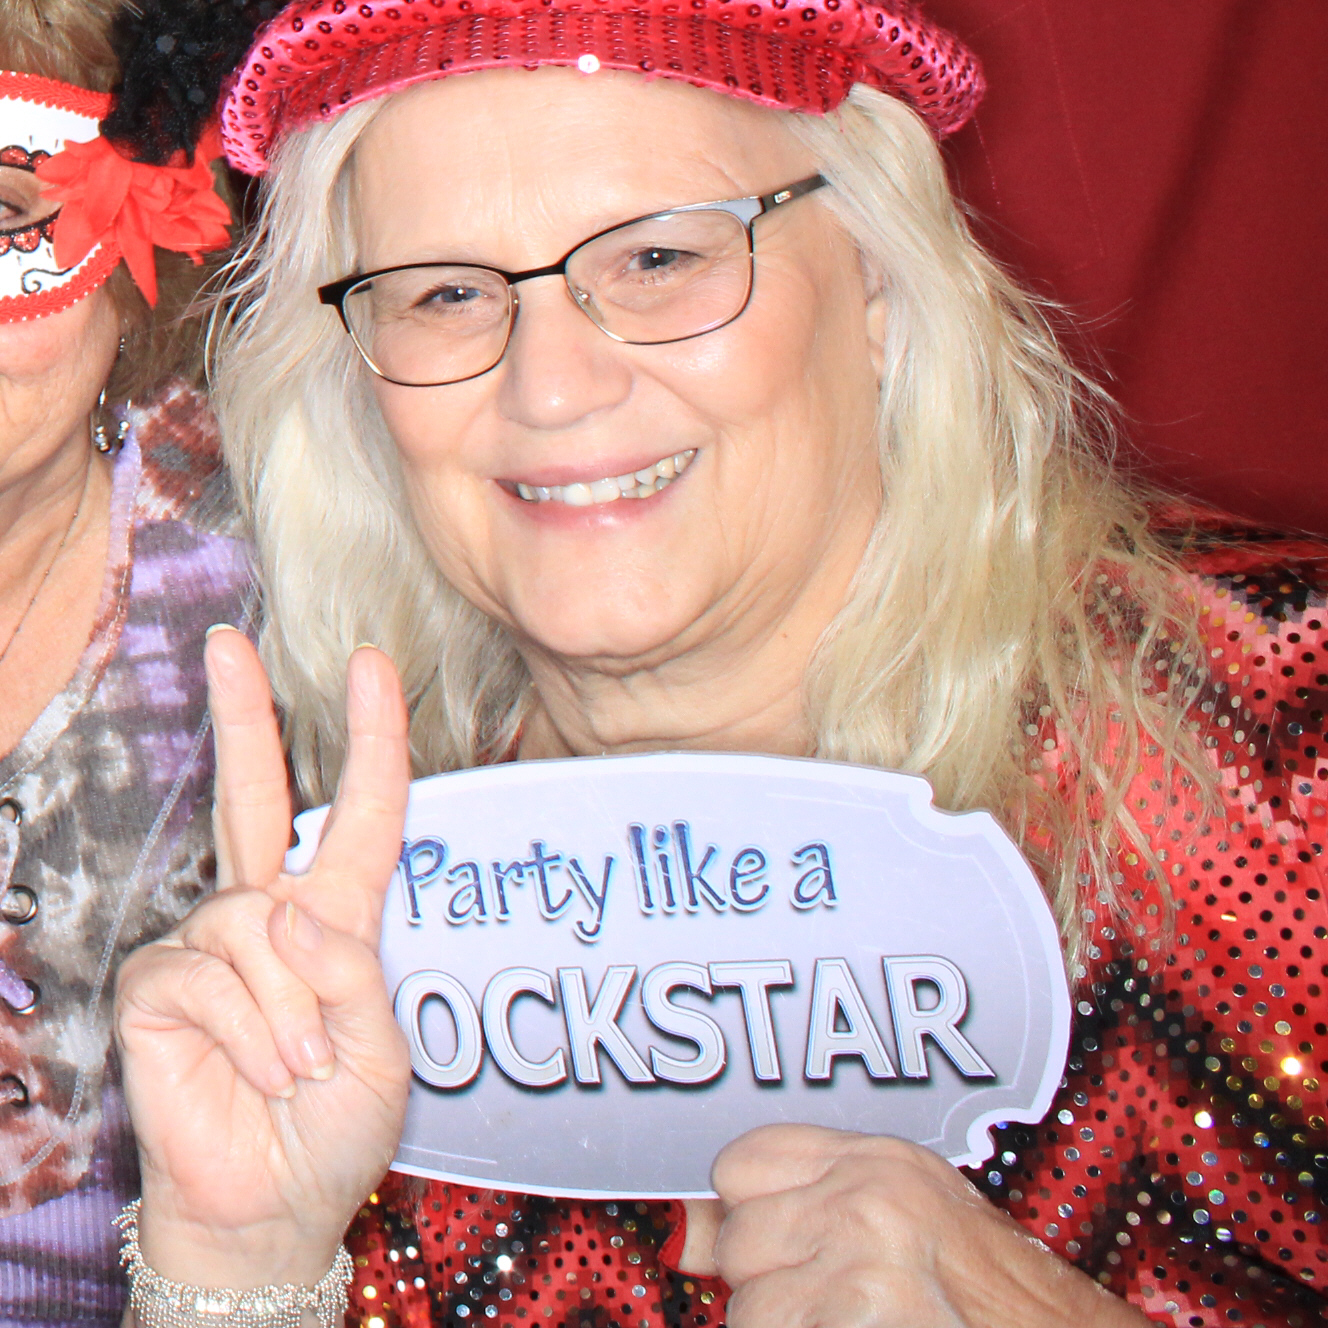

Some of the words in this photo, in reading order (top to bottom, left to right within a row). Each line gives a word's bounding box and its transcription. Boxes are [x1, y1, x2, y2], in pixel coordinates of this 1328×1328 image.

[397, 836, 615, 945] Party
[628, 820, 771, 915] like
[790, 839, 840, 912] a
[393, 955, 996, 1089] OCKSTAR
